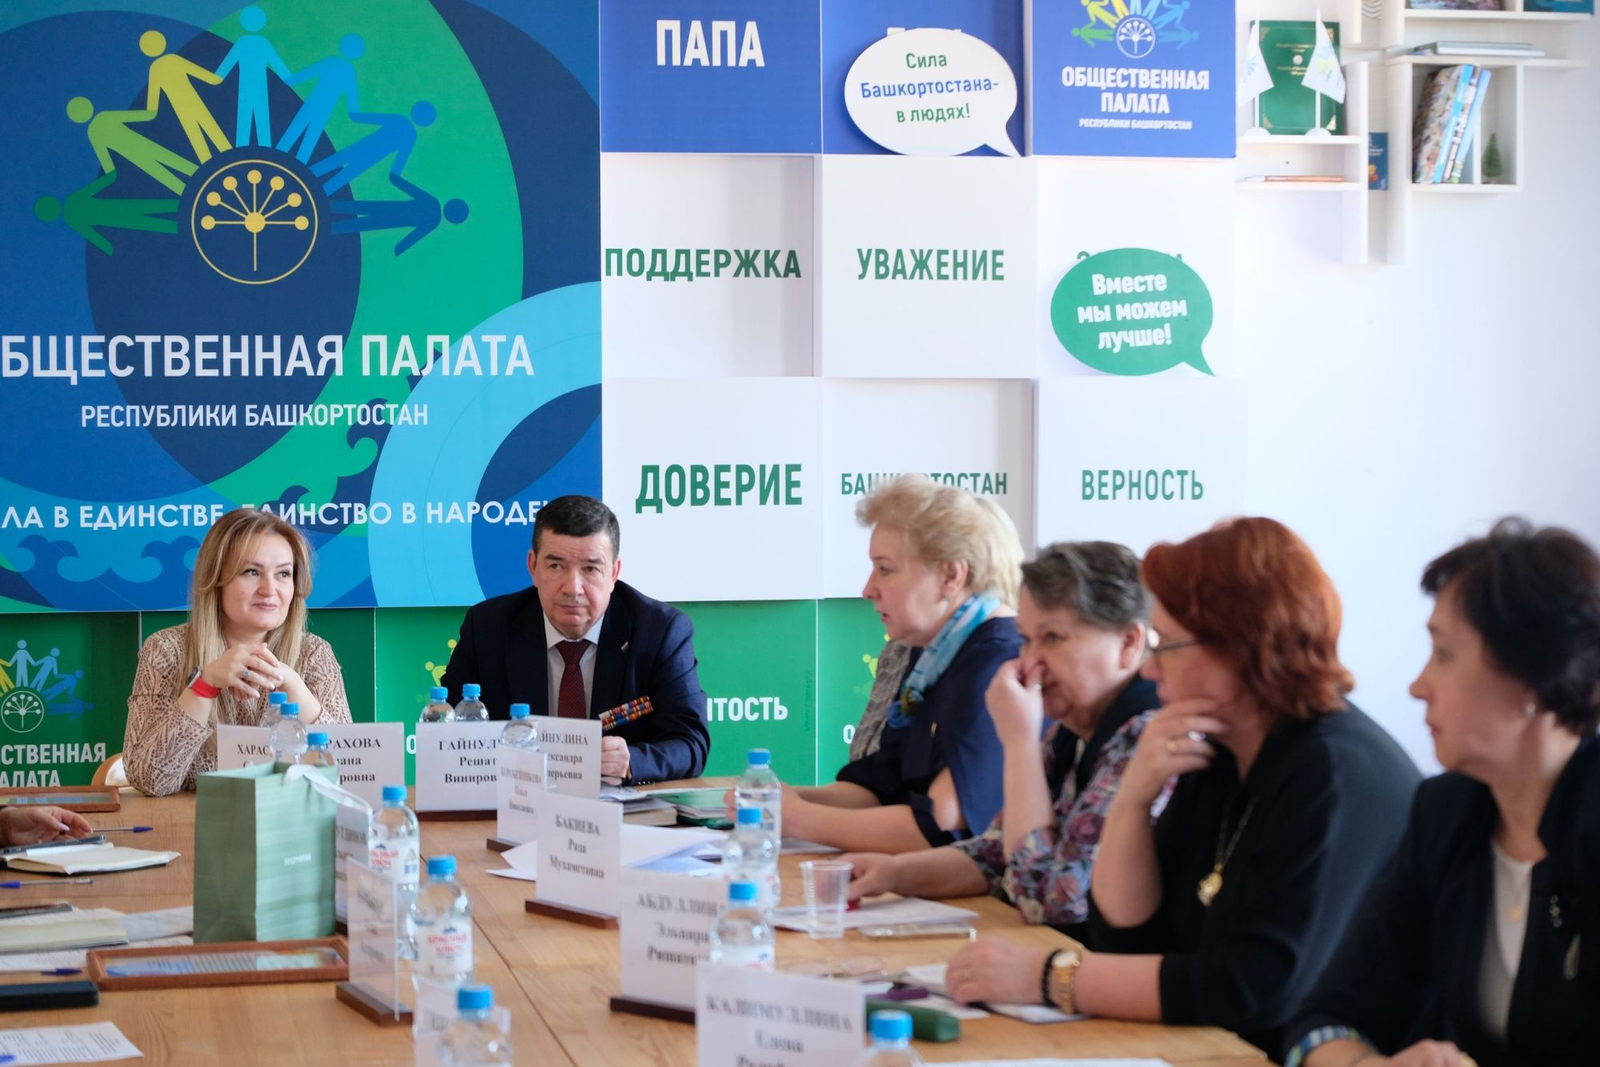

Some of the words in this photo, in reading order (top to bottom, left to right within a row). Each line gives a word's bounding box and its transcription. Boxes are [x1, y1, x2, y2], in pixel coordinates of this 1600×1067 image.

[656, 19, 765, 67] ПАПА
[905, 53, 947, 69] Сила
[860, 78, 999, 99] Башкортостана-
[1061, 66, 1210, 91] ОБЩЕСТВЕННАЯ
[896, 110, 906, 123] в
[910, 103, 970, 123] людях!
[1100, 92, 1171, 114] ПАЛАТА
[605, 248, 802, 282] ПОДДЕРЖКА
[857, 248, 1005, 281] УВАЖЕНИЕ
[1091, 273, 1168, 296] Вместе
[1077, 304, 1112, 324] мы
[1115, 299, 1188, 321] можем
[1098, 322, 1173, 353] лучше!
[1, 334, 343, 385] БЩЕСТВЕННАЯ
[361, 334, 535, 376] ПАЛАТА
[81, 404, 237, 427] РЕСПУБЛИКИ
[245, 403, 428, 426] БАШКОРТОСТАН
[635, 463, 803, 513] ДОВЕРИЕ
[1081, 469, 1204, 500] ВЕРНОСТЬ
[1, 506, 44, 529] ЛА
[54, 505, 69, 528] В
[80, 503, 224, 531] ЕДИНСТВЕ
[242, 502, 392, 525] ИНСТВО
[402, 502, 417, 524] В
[427, 500, 548, 526] НАРОДЕ
[1, 743, 106, 765] СТВЕННАЯ
[237, 744, 272, 757] ХАРАС
[439, 739, 500, 751] ГАЙНУЛ
[459, 756, 496, 767] Решат
